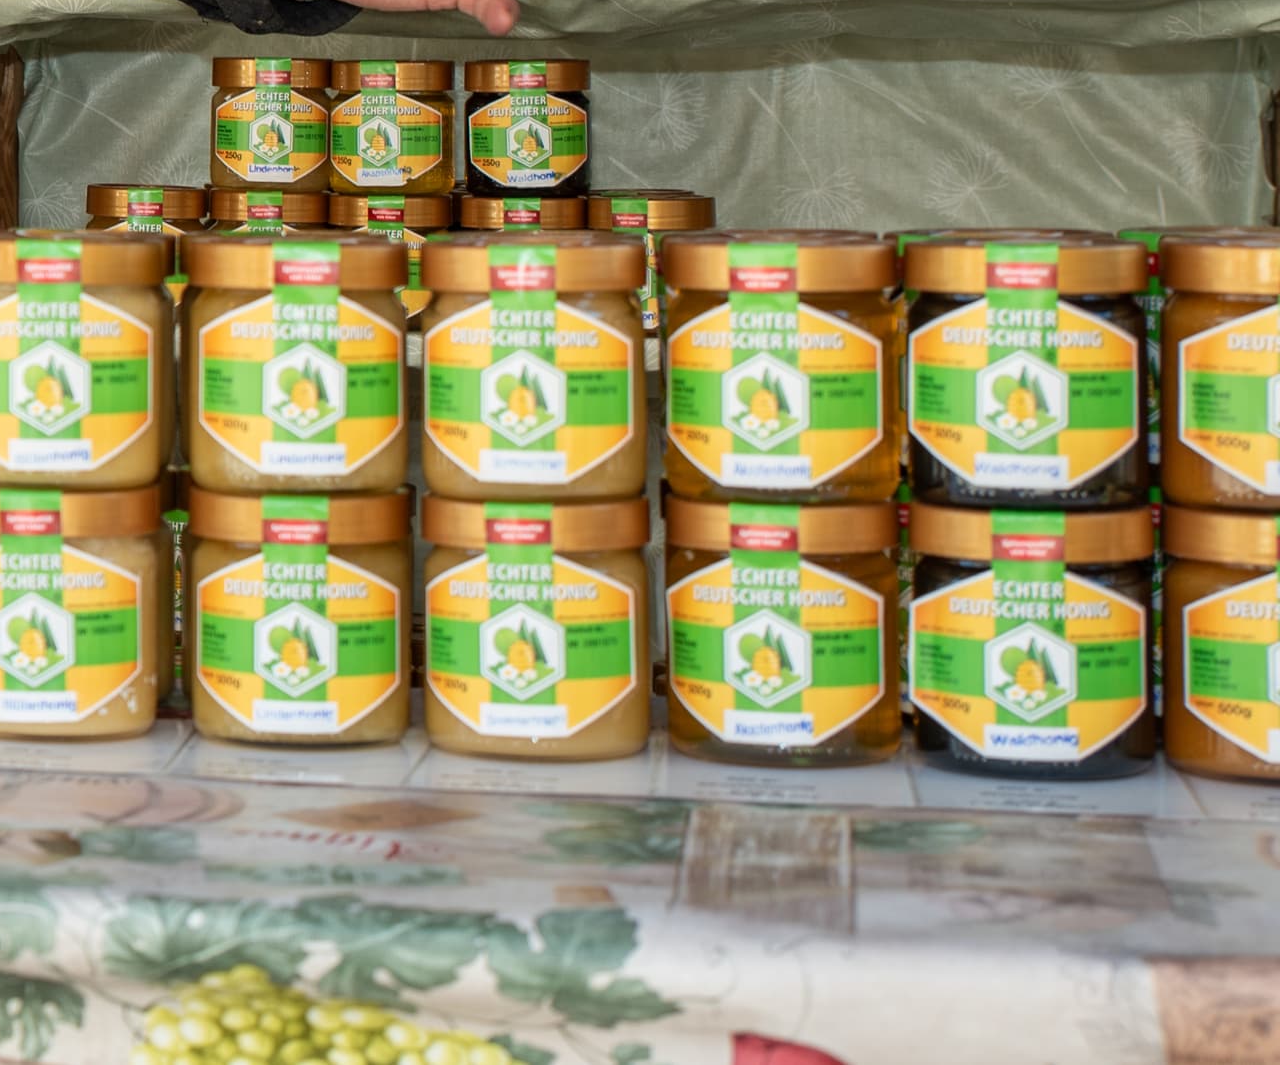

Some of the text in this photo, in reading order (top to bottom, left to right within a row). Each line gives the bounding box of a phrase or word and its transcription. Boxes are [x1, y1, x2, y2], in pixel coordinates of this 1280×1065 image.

[255, 92, 290, 102] ECHTER
[361, 96, 396, 105] ECHTER
[510, 96, 547, 105] ECHTER
[233, 102, 312, 113] DEUTSCHER HONIG
[343, 106, 420, 115] DEUTSCHER HONIG
[488, 106, 571, 117] DEUTSCHER HONIG
[128, 223, 162, 233] ECHTER
[18, 301, 80, 319] ECHTER
[273, 304, 338, 321] ECHTER
[490, 310, 555, 328] ECHTER
[988, 308, 1057, 328] ECHTER
[70, 321, 121, 338] HONIG
[730, 312, 798, 330] ECHTER
[231, 322, 375, 342] DEUTSCHER HONIG
[450, 328, 599, 348] DEUTSCHER HONIG
[692, 331, 845, 351] DEUTSCHER HONIG
[944, 327, 1104, 349] DEUTSCHER HONIG
[1, 553, 62, 570] ECHTER
[264, 563, 326, 581] ECHTER
[487, 562, 553, 581] ECHTER
[731, 568, 800, 586] ECHTER
[53, 572, 105, 590] HONIG
[993, 580, 1064, 600] ECHTER
[223, 581, 368, 601] DEUTSCHER HONIG
[449, 580, 597, 601] DEUTSCHER HONIG
[693, 586, 846, 608] DEUTSCHER HONIG
[950, 599, 1111, 621] DEUTSCHER HONIG
